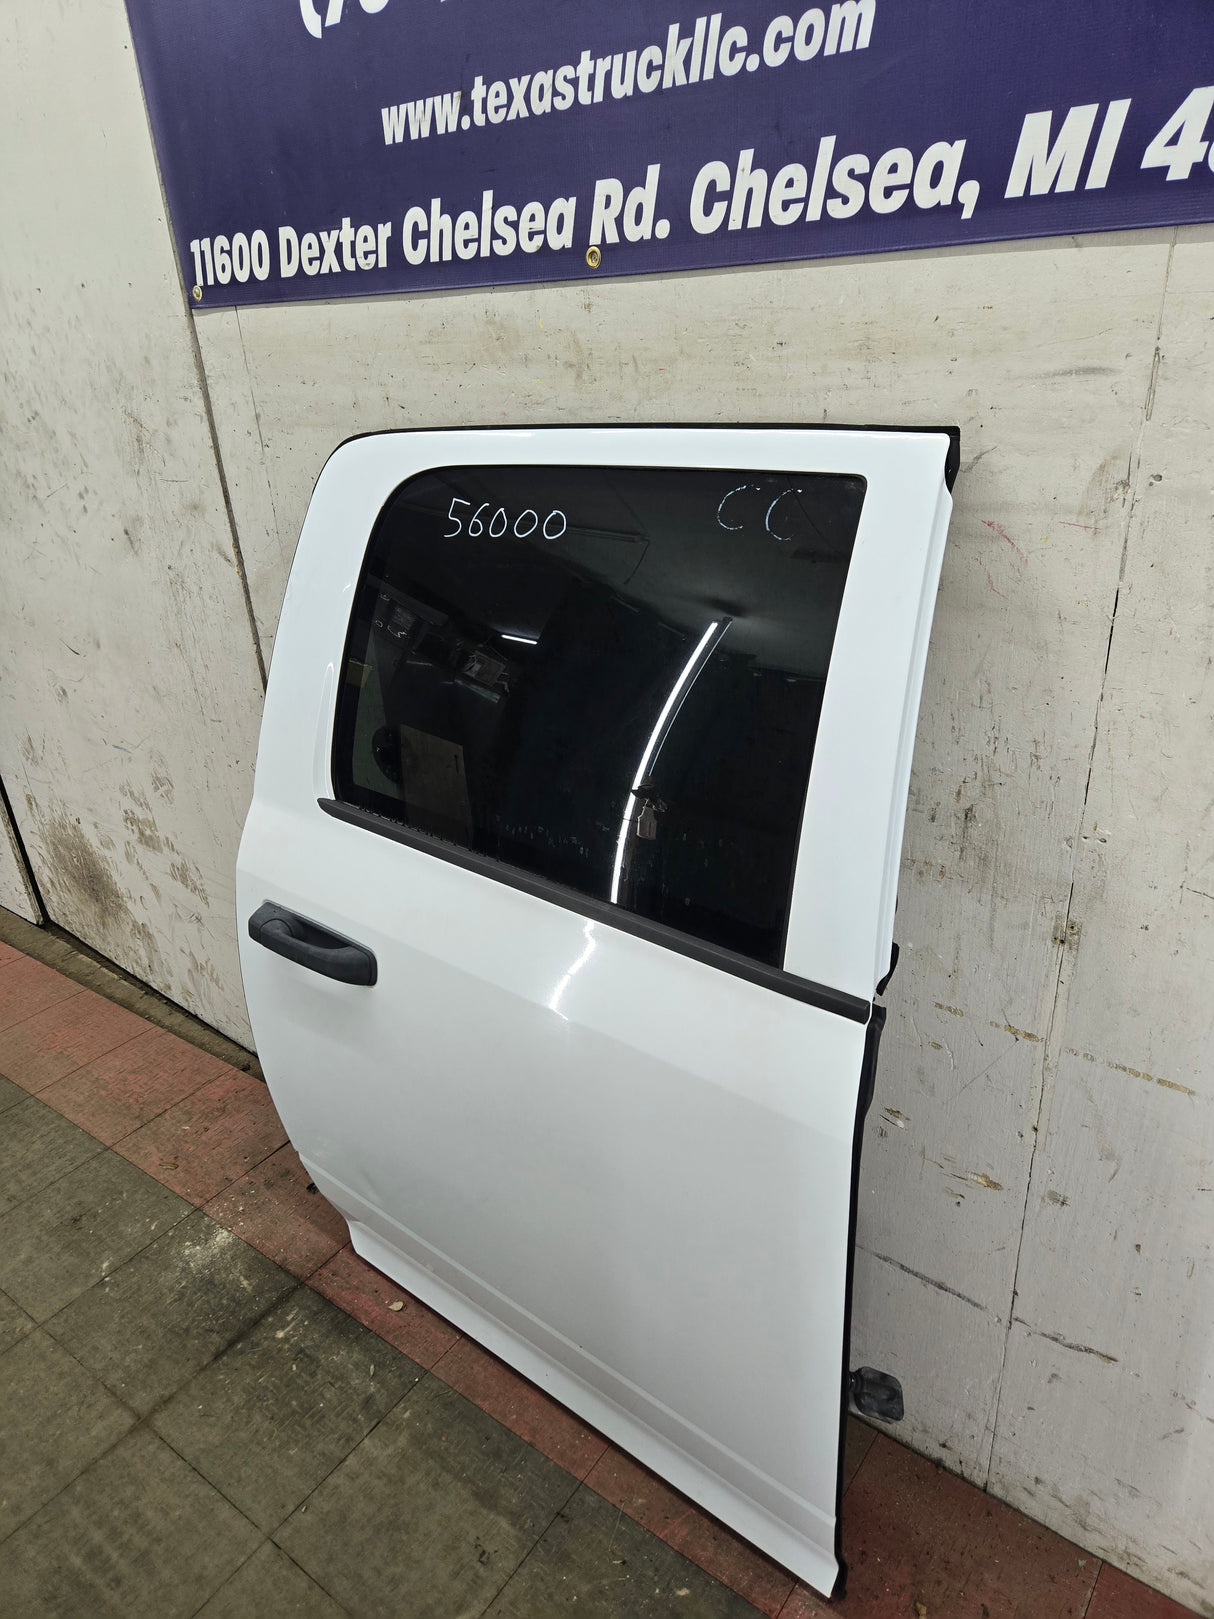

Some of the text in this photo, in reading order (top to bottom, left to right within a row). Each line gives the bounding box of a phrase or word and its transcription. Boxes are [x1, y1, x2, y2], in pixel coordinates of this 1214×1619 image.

[382, 0, 876, 146] www.texastruckllc.com
[190, 85, 1214, 287] 11600 Dexter Chelsea Rd. Chelsea, MI 4
[442, 497, 568, 541] 56000
